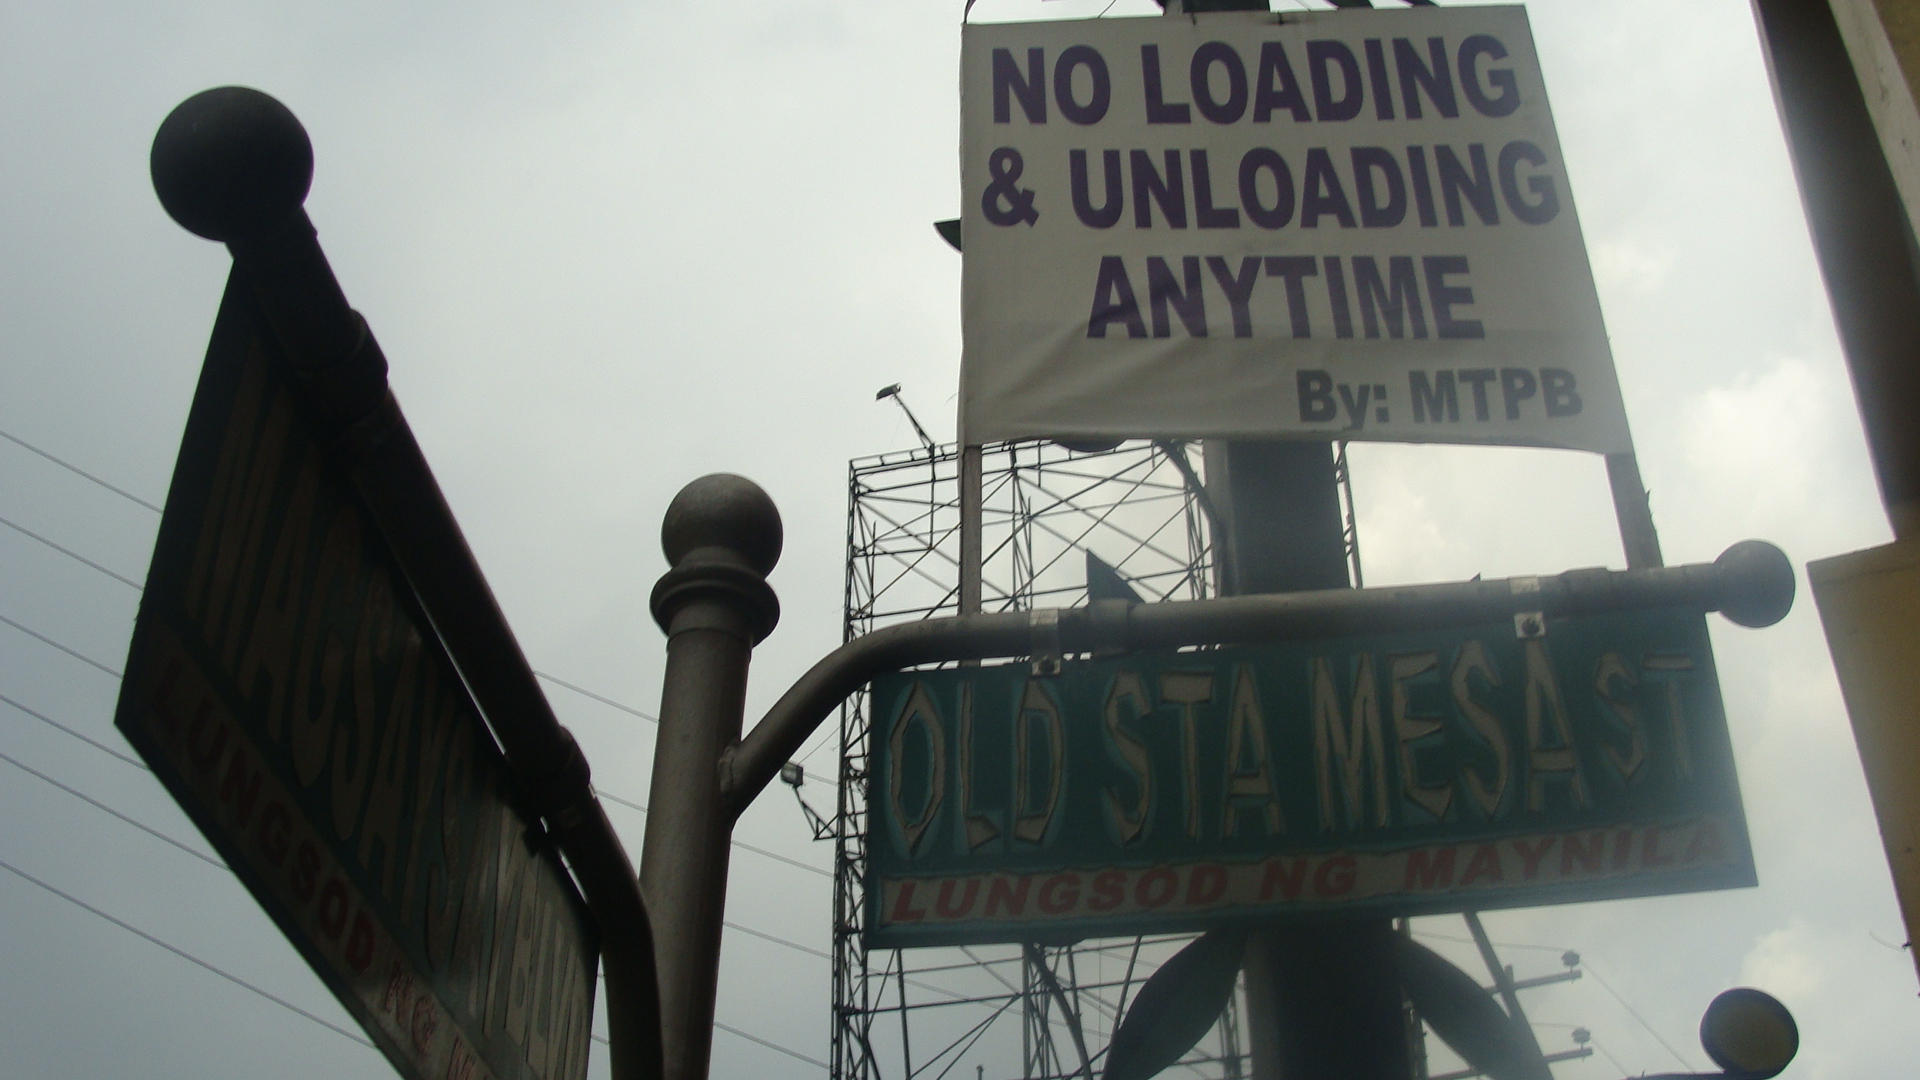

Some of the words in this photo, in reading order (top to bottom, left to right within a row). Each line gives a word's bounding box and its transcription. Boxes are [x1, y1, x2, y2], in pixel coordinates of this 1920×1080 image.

[992, 45, 1112, 126] NO
[1141, 33, 1521, 126] LOADING
[981, 146, 1040, 228] &
[1069, 140, 1561, 230] UNLOADING
[1086, 255, 1485, 340] ANYTIME
[1296, 369, 1390, 430] By:
[1409, 367, 1584, 424] MTPB
[887, 676, 1064, 857] OLD
[1103, 661, 1283, 848] STA
[1308, 634, 1588, 831] MESA
[1595, 650, 1698, 784] ST
[147, 655, 376, 973] LUNGSOD
[384, 956, 438, 1056] NG
[891, 862, 1228, 923] LUNGSOD
[1260, 856, 1358, 900] NG
[1404, 822, 1726, 891] MAYNILA
